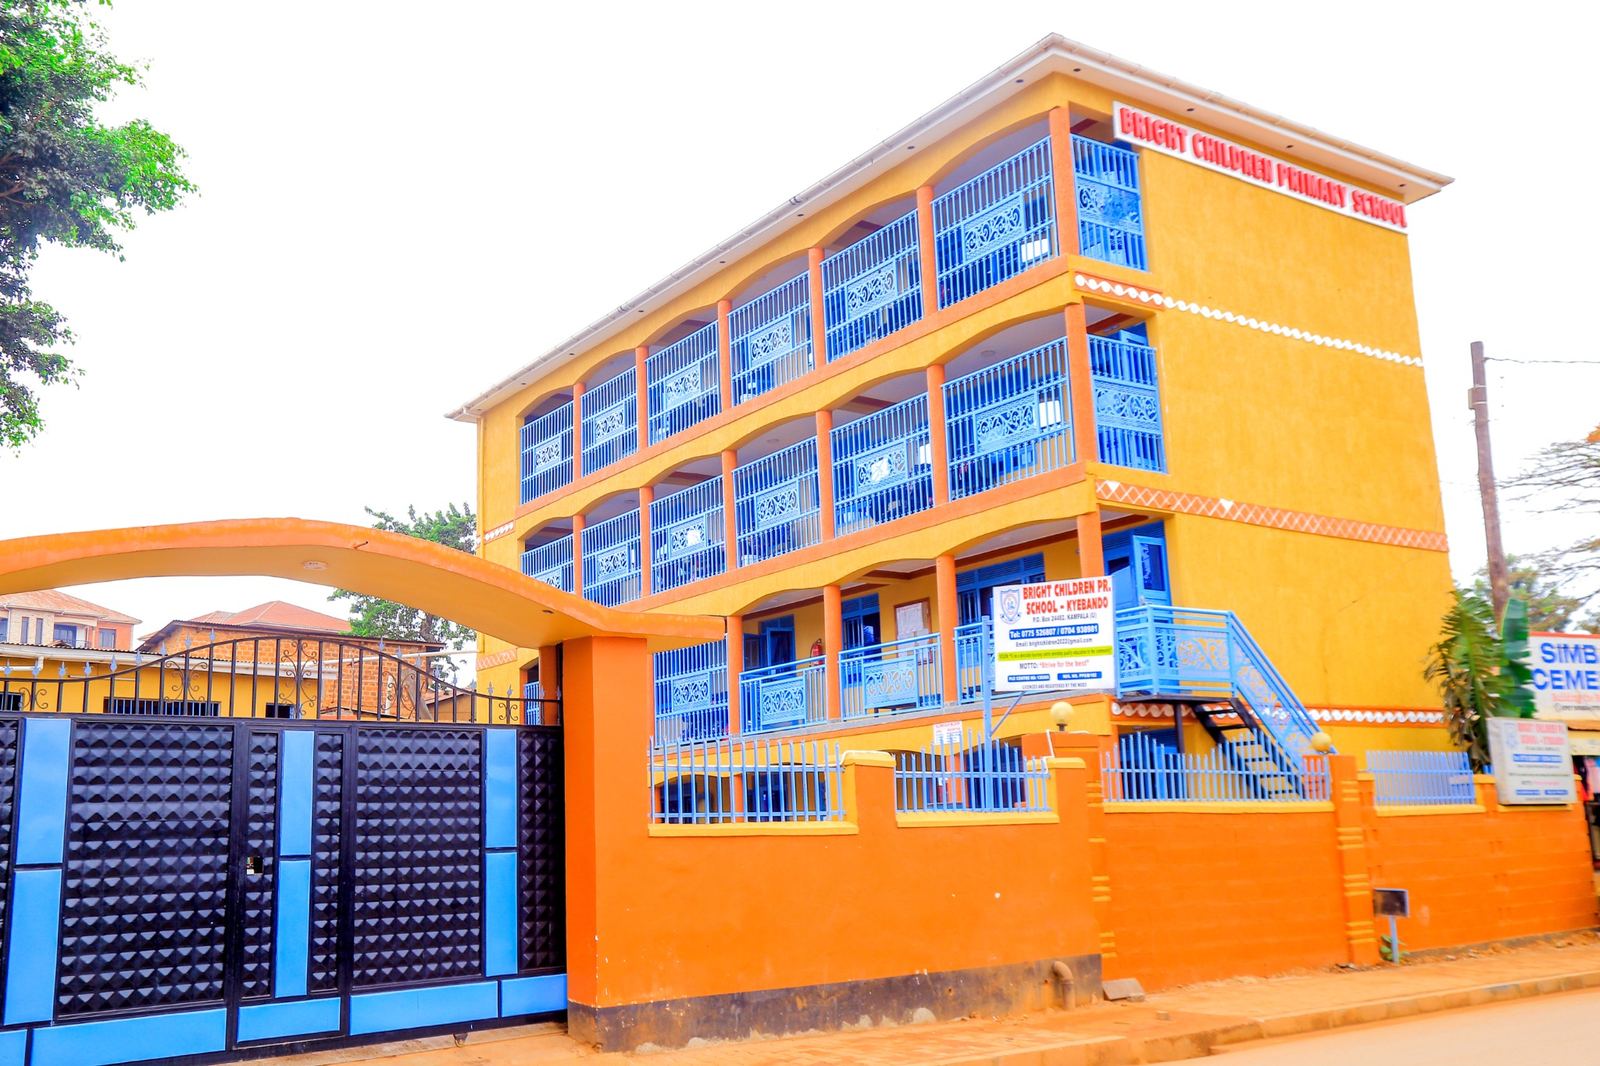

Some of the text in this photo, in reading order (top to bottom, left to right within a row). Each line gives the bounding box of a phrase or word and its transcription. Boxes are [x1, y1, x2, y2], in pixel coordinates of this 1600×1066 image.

[1120, 107, 1408, 228] BRIGHT CHILDREN PRIMARY SCHOOL
[1023, 579, 1111, 600] BRIGHT CHILDREN PR.
[1026, 600, 1058, 615] SCHOOL
[1066, 597, 1108, 612] KYEBANDO
[1067, 612, 1089, 620] KAMPALA
[1010, 630, 1021, 639] Tel:
[1540, 642, 1600, 664] SIMB
